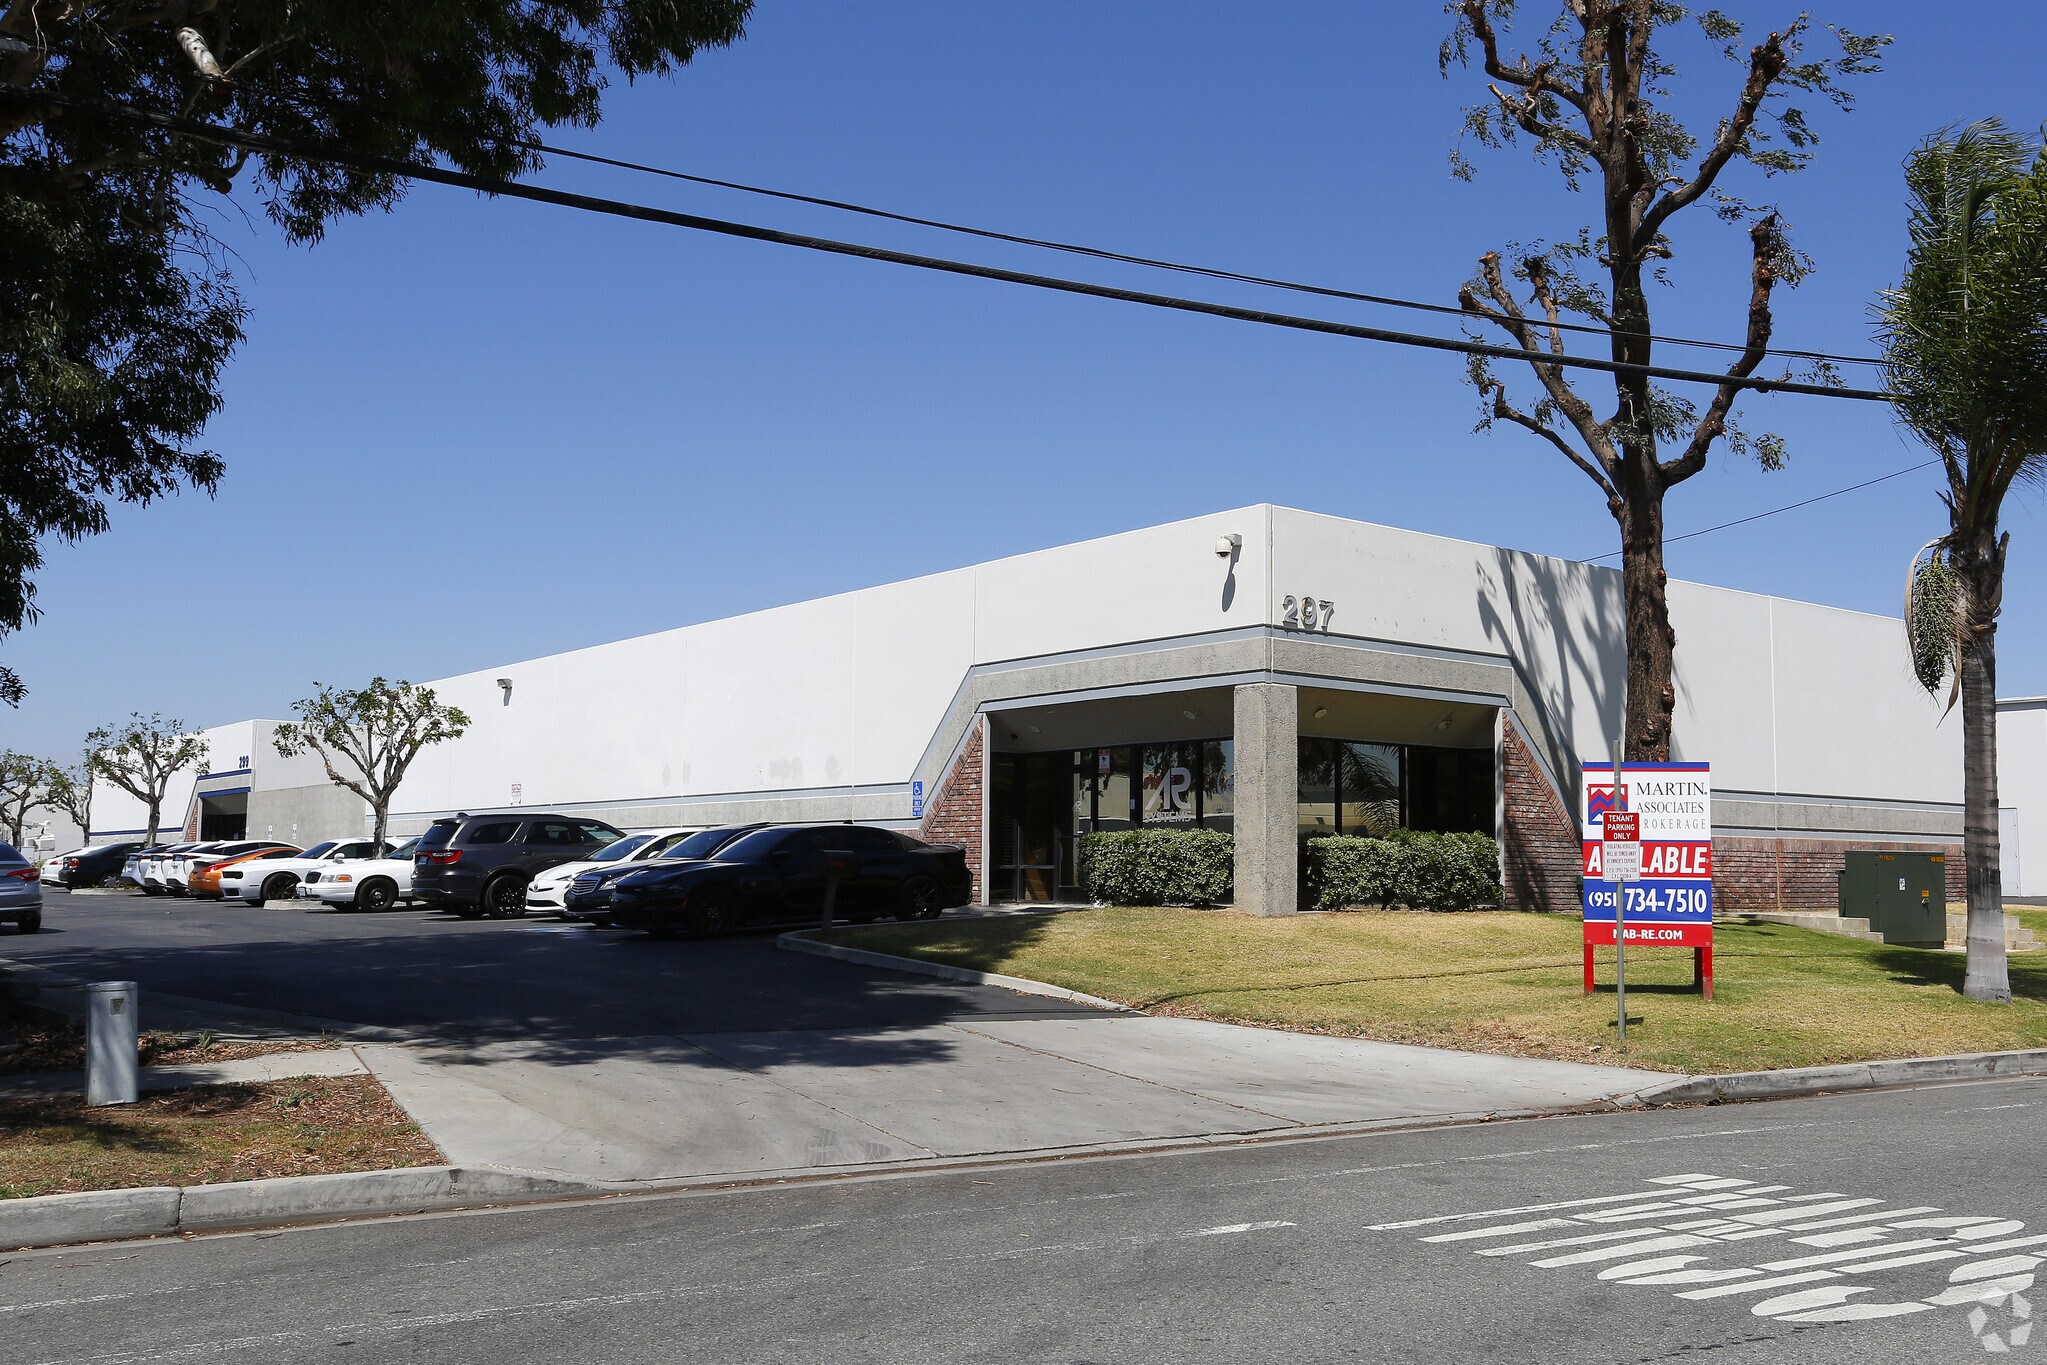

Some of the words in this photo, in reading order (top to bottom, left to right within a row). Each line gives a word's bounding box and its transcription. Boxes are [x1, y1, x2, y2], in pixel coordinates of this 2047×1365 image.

[1282, 594, 1335, 629] 297
[1144, 767, 1192, 811] AR
[1636, 782, 1704, 796] MARTIN
[1636, 801, 1705, 814] ASSOCIATES
[1144, 810, 1191, 823] SYSTEMS
[1609, 814, 1634, 822] TENANT
[1607, 823, 1635, 831] PARKING
[1640, 818, 1706, 830] ROKERAGE
[1613, 832, 1631, 840] ONLY
[1587, 846, 1708, 874] ALABLE
[1588, 892, 1617, 907] (951
[1625, 888, 1707, 913] 734-7510
